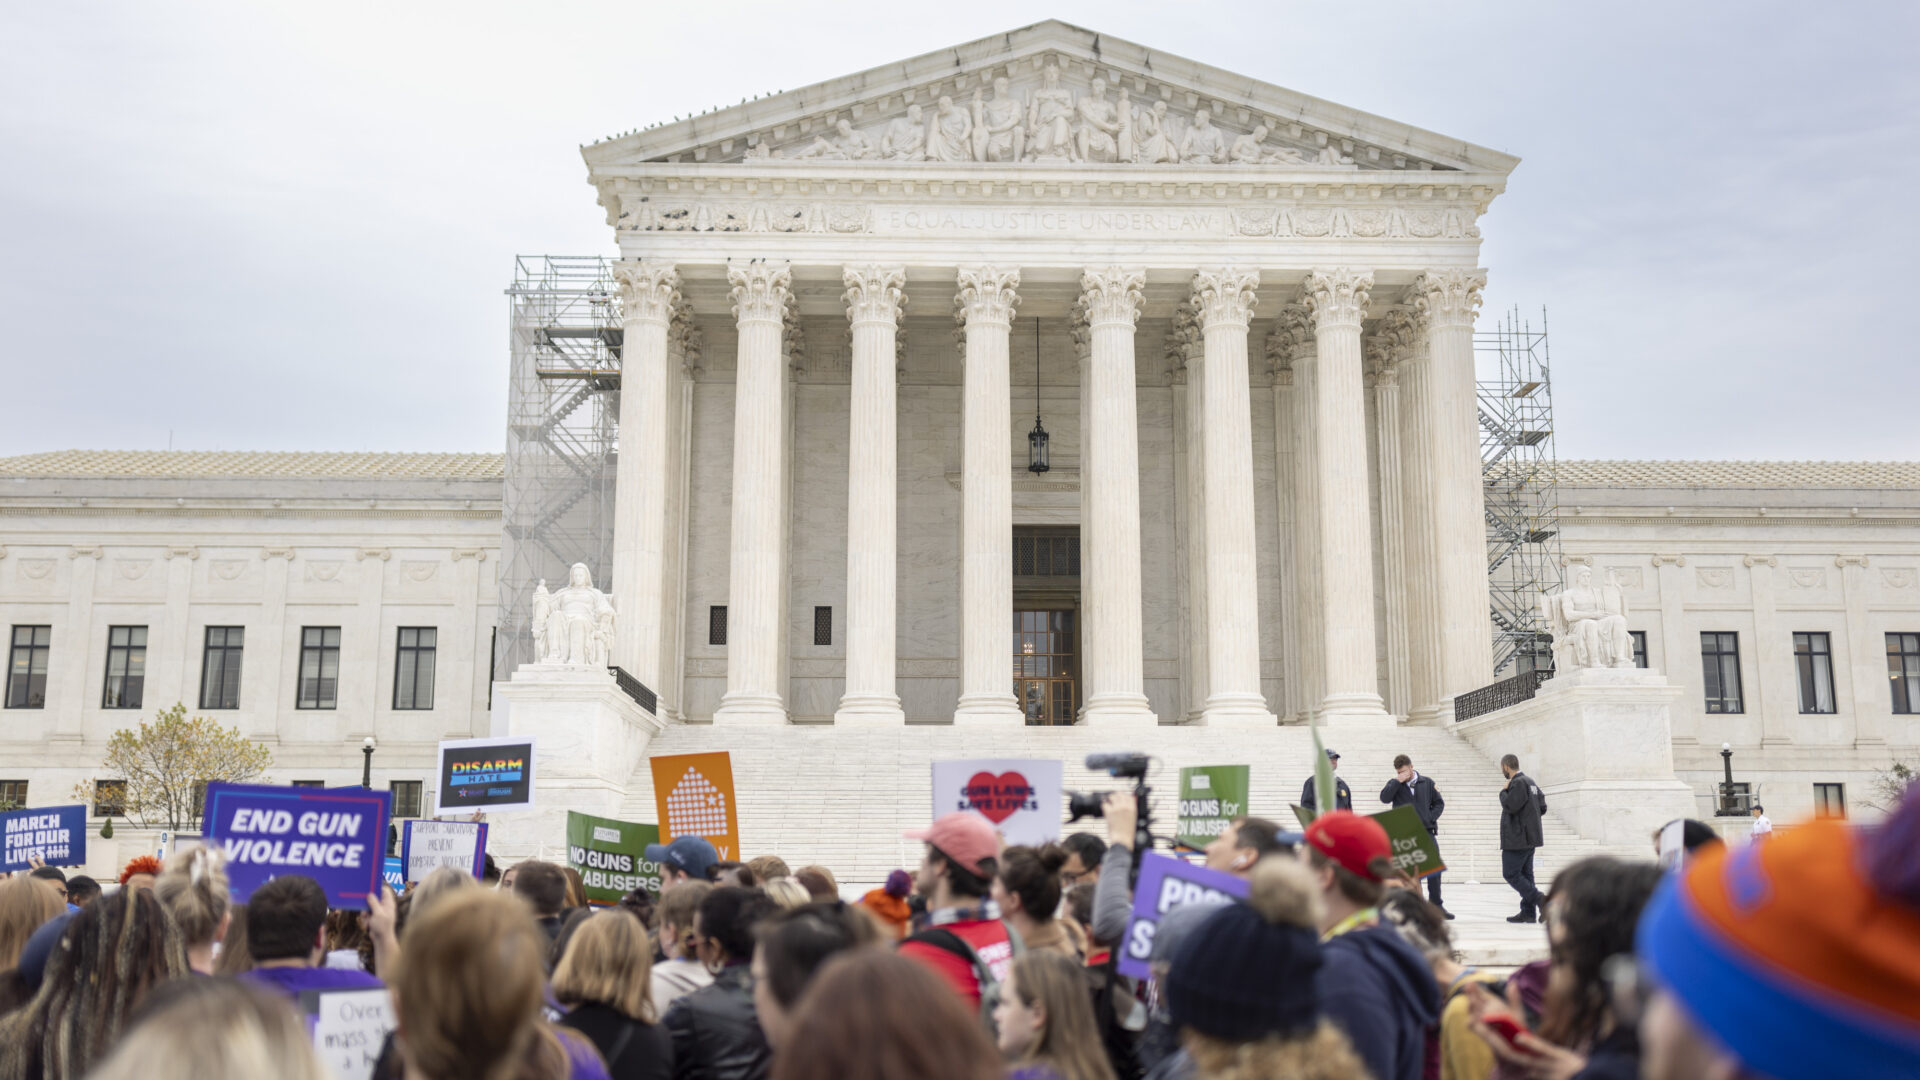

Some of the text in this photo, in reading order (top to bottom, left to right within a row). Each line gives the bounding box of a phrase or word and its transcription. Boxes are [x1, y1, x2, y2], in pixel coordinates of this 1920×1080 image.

[889, 211, 1213, 231] EQUAL JUSTICE UNDER LAW
[451, 757, 523, 774] DISARM
[468, 774, 502, 784] HATE
[960, 784, 1036, 797] GUN LAWS
[957, 799, 1039, 811] SAVE LIVES
[1189, 799, 1220, 817] GUNS
[1221, 799, 1240, 816] for
[5, 814, 61, 834] MARCH
[230, 808, 362, 838] END GUN
[1190, 819, 1231, 836] ABUSER
[5, 829, 70, 849] FOR OUR
[5, 846, 46, 864] LIVES
[224, 838, 365, 868] VIOLENCE
[570, 845, 586, 865] NO
[587, 849, 632, 872] GUNS
[636, 857, 660, 873] for
[582, 869, 661, 892] ABUSERS
